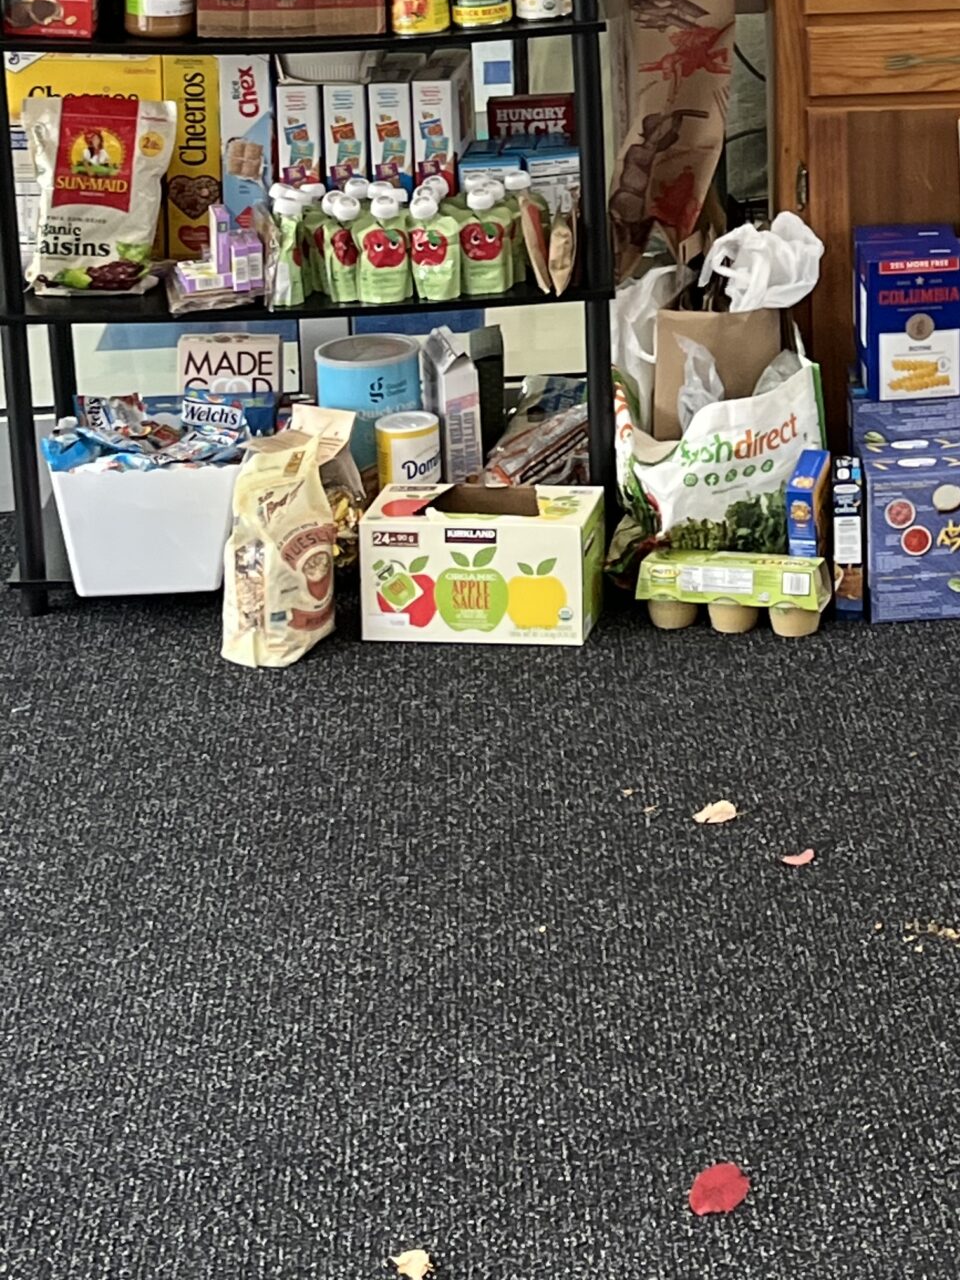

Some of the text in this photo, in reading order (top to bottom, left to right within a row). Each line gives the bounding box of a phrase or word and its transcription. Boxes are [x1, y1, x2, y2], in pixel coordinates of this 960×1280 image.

[231, 80, 240, 100] Rice
[238, 66, 260, 118] Chex
[179, 71, 207, 166] Cheerios
[496, 106, 567, 121] HUNGRY
[496, 120, 570, 137] JACK
[56, 175, 128, 193] SUN-MAID
[40, 235, 111, 257] aisins
[879, 287, 960, 306] COLUMBIA
[184, 350, 274, 376] MADE
[183, 404, 239, 426] Welch's
[373, 532, 391, 545] 24
[447, 529, 497, 540] KIRKLAND
[445, 573, 497, 582] ORGANIC
[452, 580, 490, 595] APPLE
[452, 594, 491, 610] SAUCE
